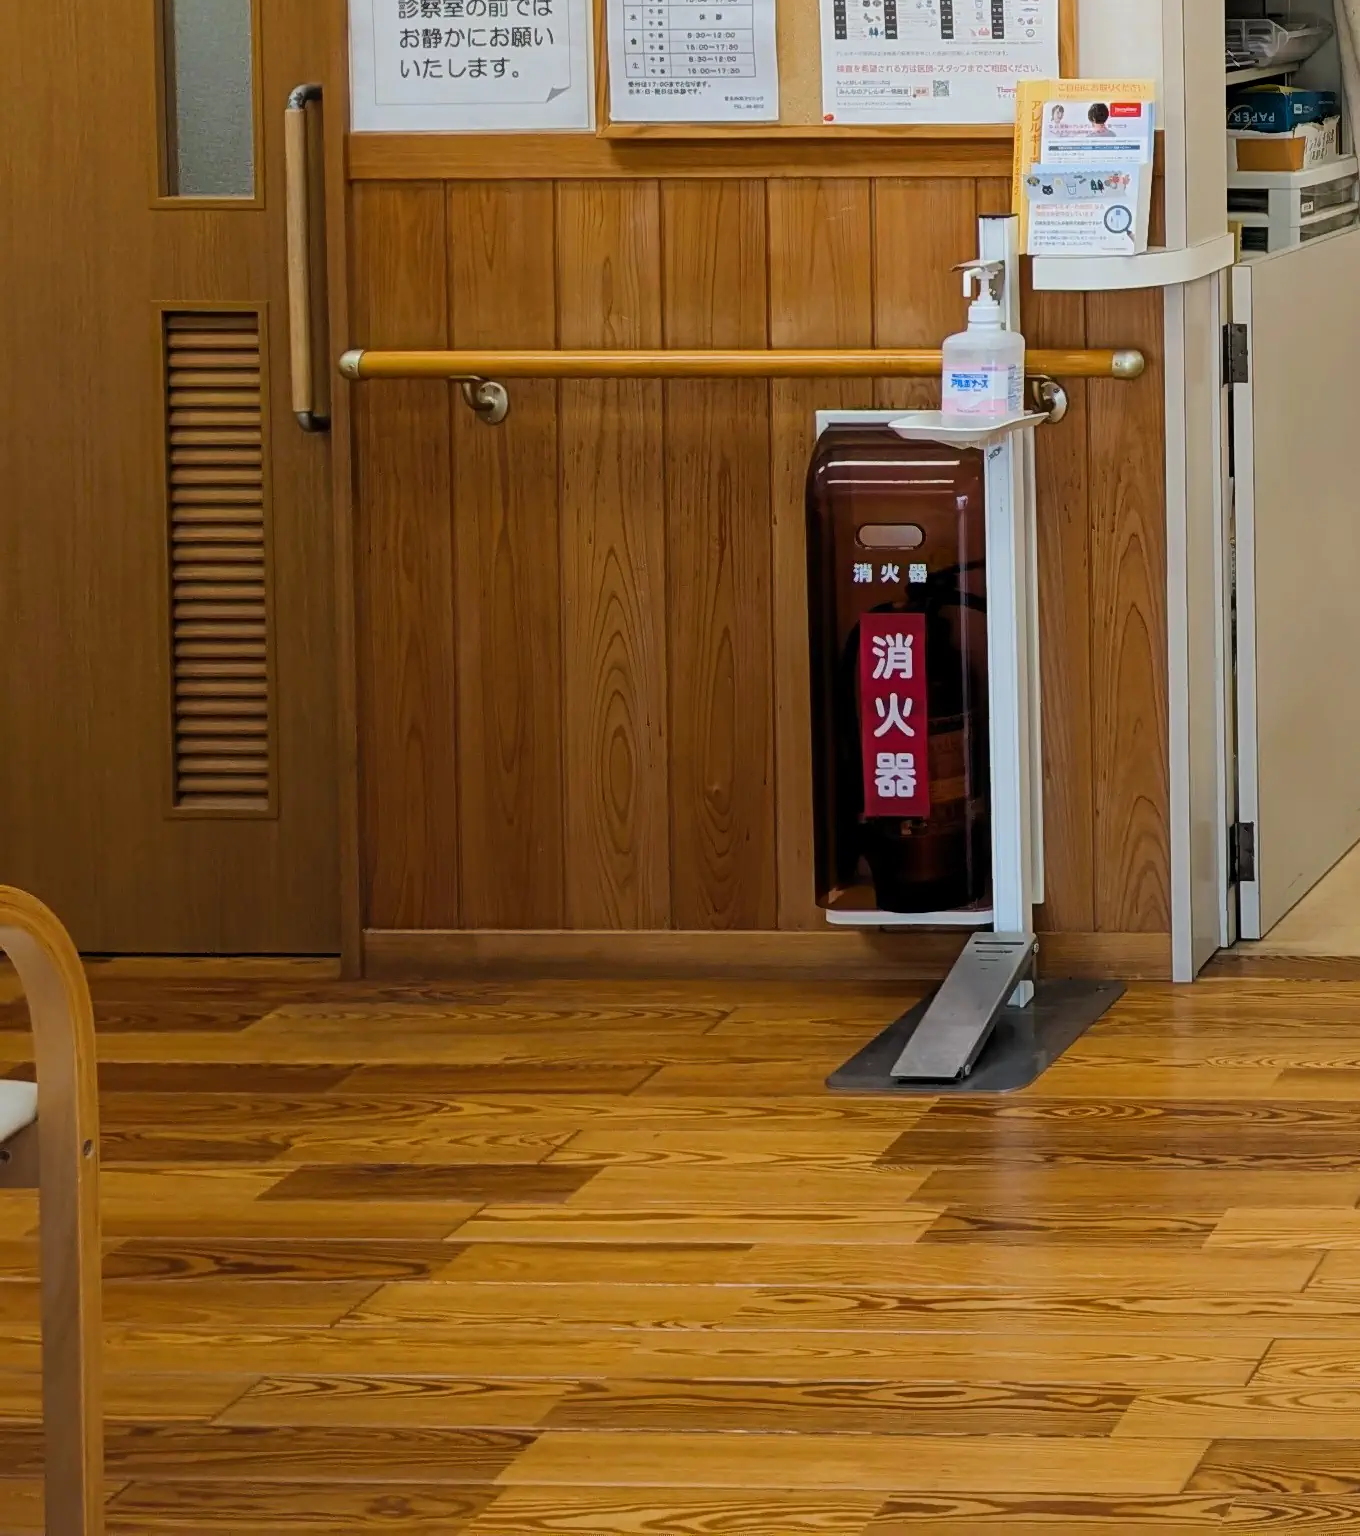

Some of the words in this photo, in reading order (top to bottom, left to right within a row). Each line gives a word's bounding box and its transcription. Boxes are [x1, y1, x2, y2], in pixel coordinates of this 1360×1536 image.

[399, 27, 554, 48] お静かにお願い
[400, 57, 519, 79] いたします。
[853, 563, 928, 583] 消火器
[871, 633, 919, 799] 消火器
